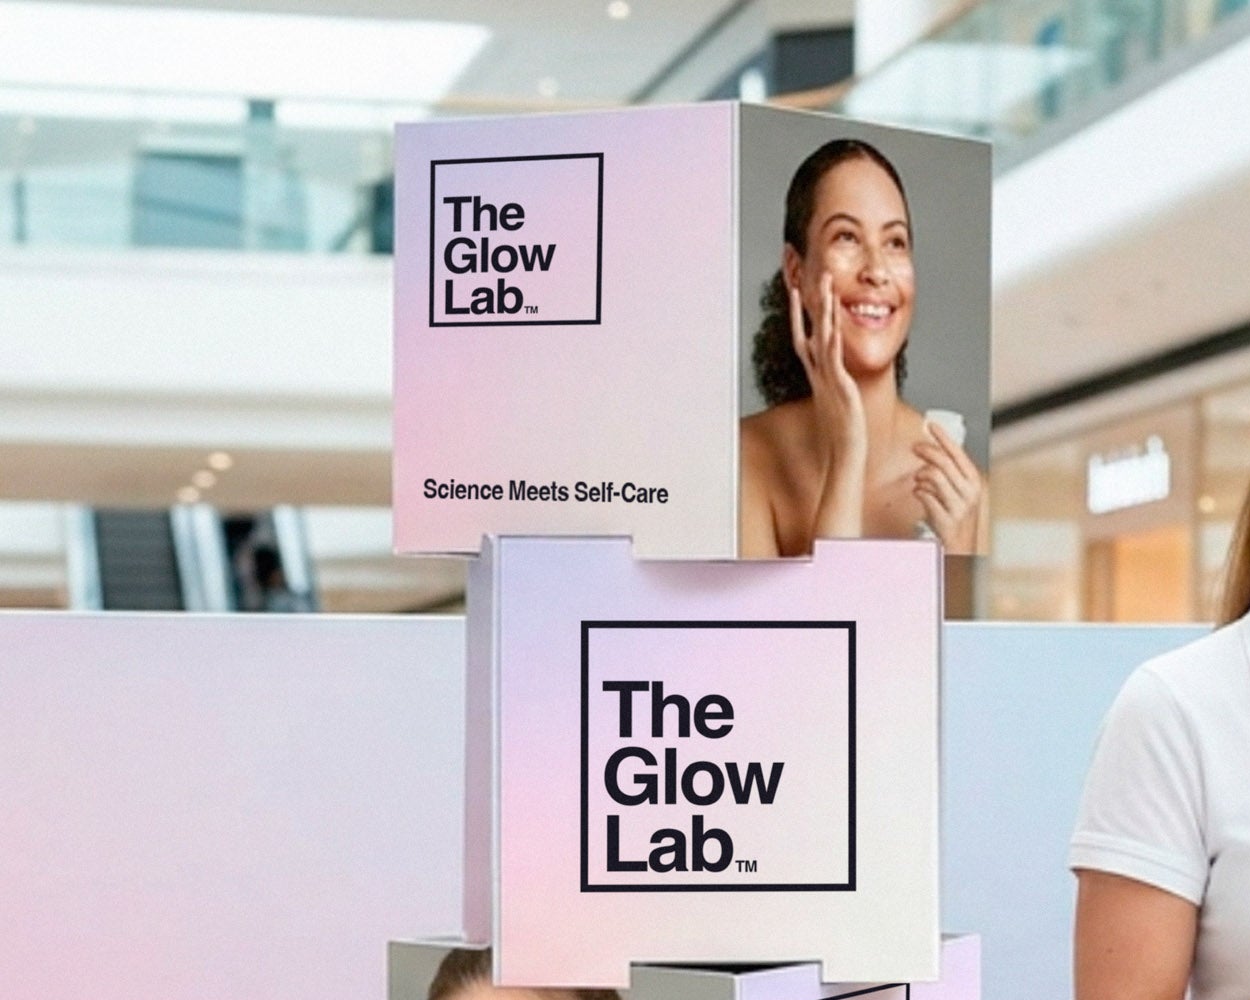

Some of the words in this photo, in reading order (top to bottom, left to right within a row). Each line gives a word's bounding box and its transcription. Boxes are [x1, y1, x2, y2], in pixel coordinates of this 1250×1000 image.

[442, 195, 525, 233] The
[443, 236, 557, 275] Glow
[423, 478, 504, 501] Science
[508, 479, 570, 502] Meets
[574, 481, 669, 504] Self-Care
[602, 680, 735, 739] The
[604, 746, 785, 807] Glow
